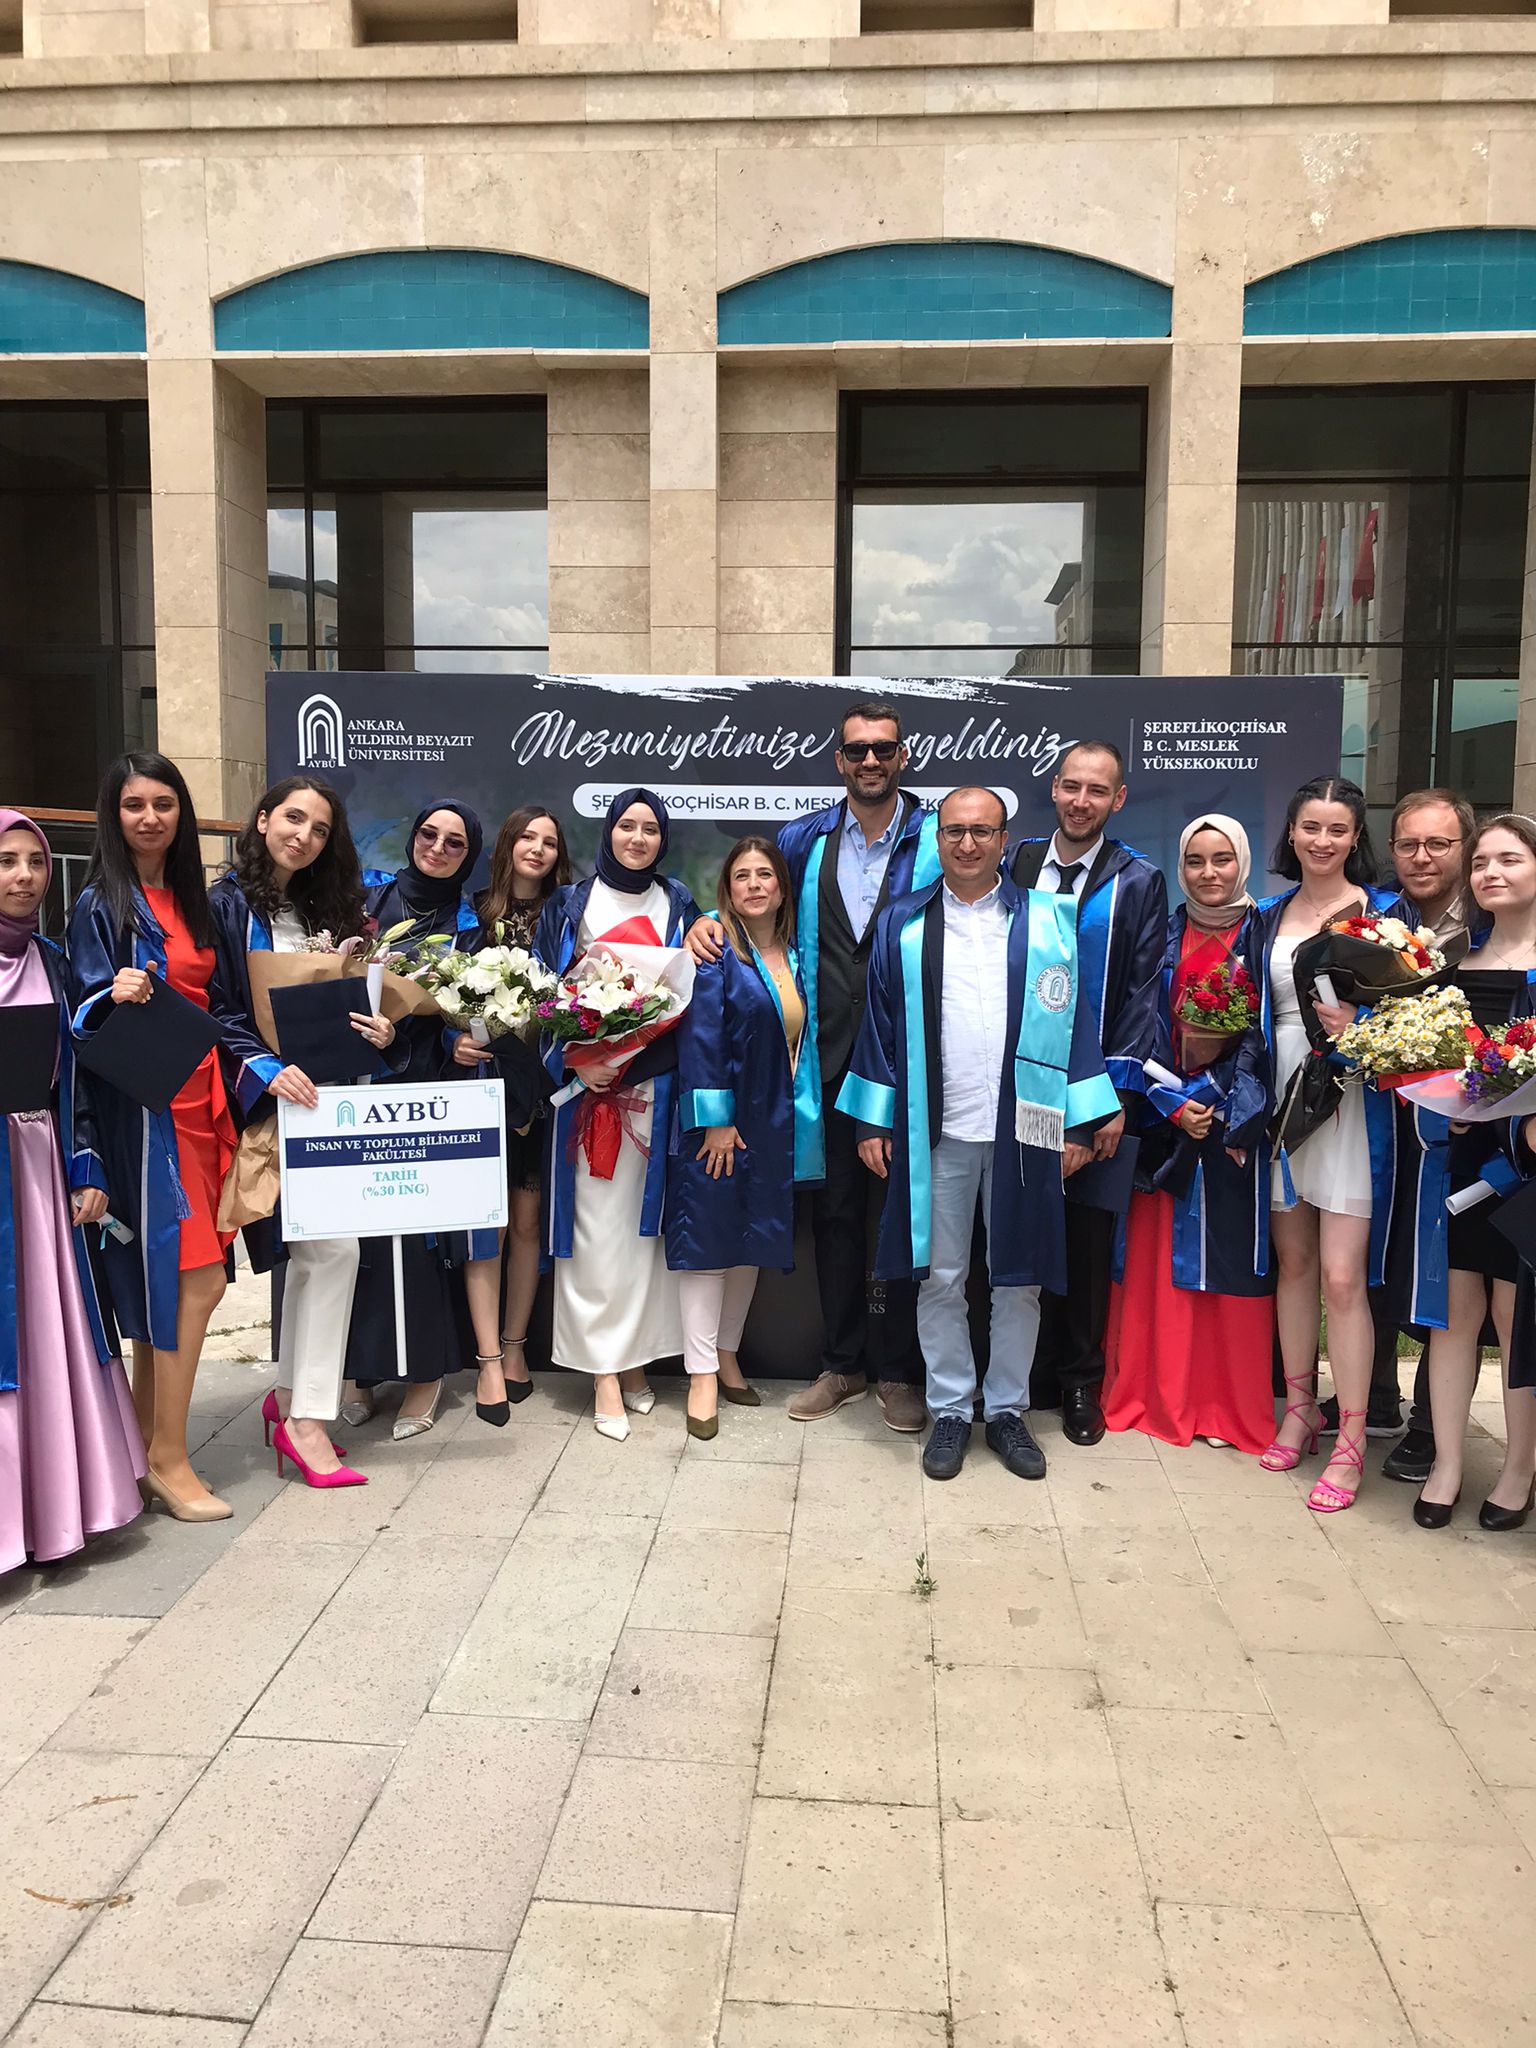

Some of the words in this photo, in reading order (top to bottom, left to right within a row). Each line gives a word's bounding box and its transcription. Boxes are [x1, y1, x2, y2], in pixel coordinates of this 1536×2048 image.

[347, 719, 405, 731] ANKARA
[1143, 718, 1288, 737] ŞEREFLİKOÇHİSAR
[347, 734, 413, 746] YILDIRIM
[416, 735, 475, 747] BEYAZIT
[511, 709, 835, 771] Mezuniyetimize
[902, 716, 1079, 777] şgeldiniz
[1143, 740, 1153, 752] B
[1157, 740, 1172, 752] C.
[1176, 740, 1240, 752] MESLEK
[348, 747, 446, 762] ÜNİVERSİTESİ
[307, 758, 337, 769] AYBÜ
[1142, 755, 1259, 770] YÜKSEKOKULU
[591, 792, 749, 812] ŞEKOÇHİSAR
[754, 797, 770, 811] B.
[774, 797, 790, 811] C.
[795, 797, 837, 811] MESL
[363, 1096, 450, 1124] AYBÜ
[305, 1139, 342, 1152] İNSAN
[344, 1139, 362, 1150] VE
[363, 1137, 416, 1149] TOPLUM
[418, 1133, 481, 1147] BİLİMLERİ
[362, 1147, 428, 1162] FAKÜLTESİ
[372, 1167, 418, 1182] TARİH
[362, 1185, 395, 1200] (%30
[398, 1181, 430, 1197] İNG)
